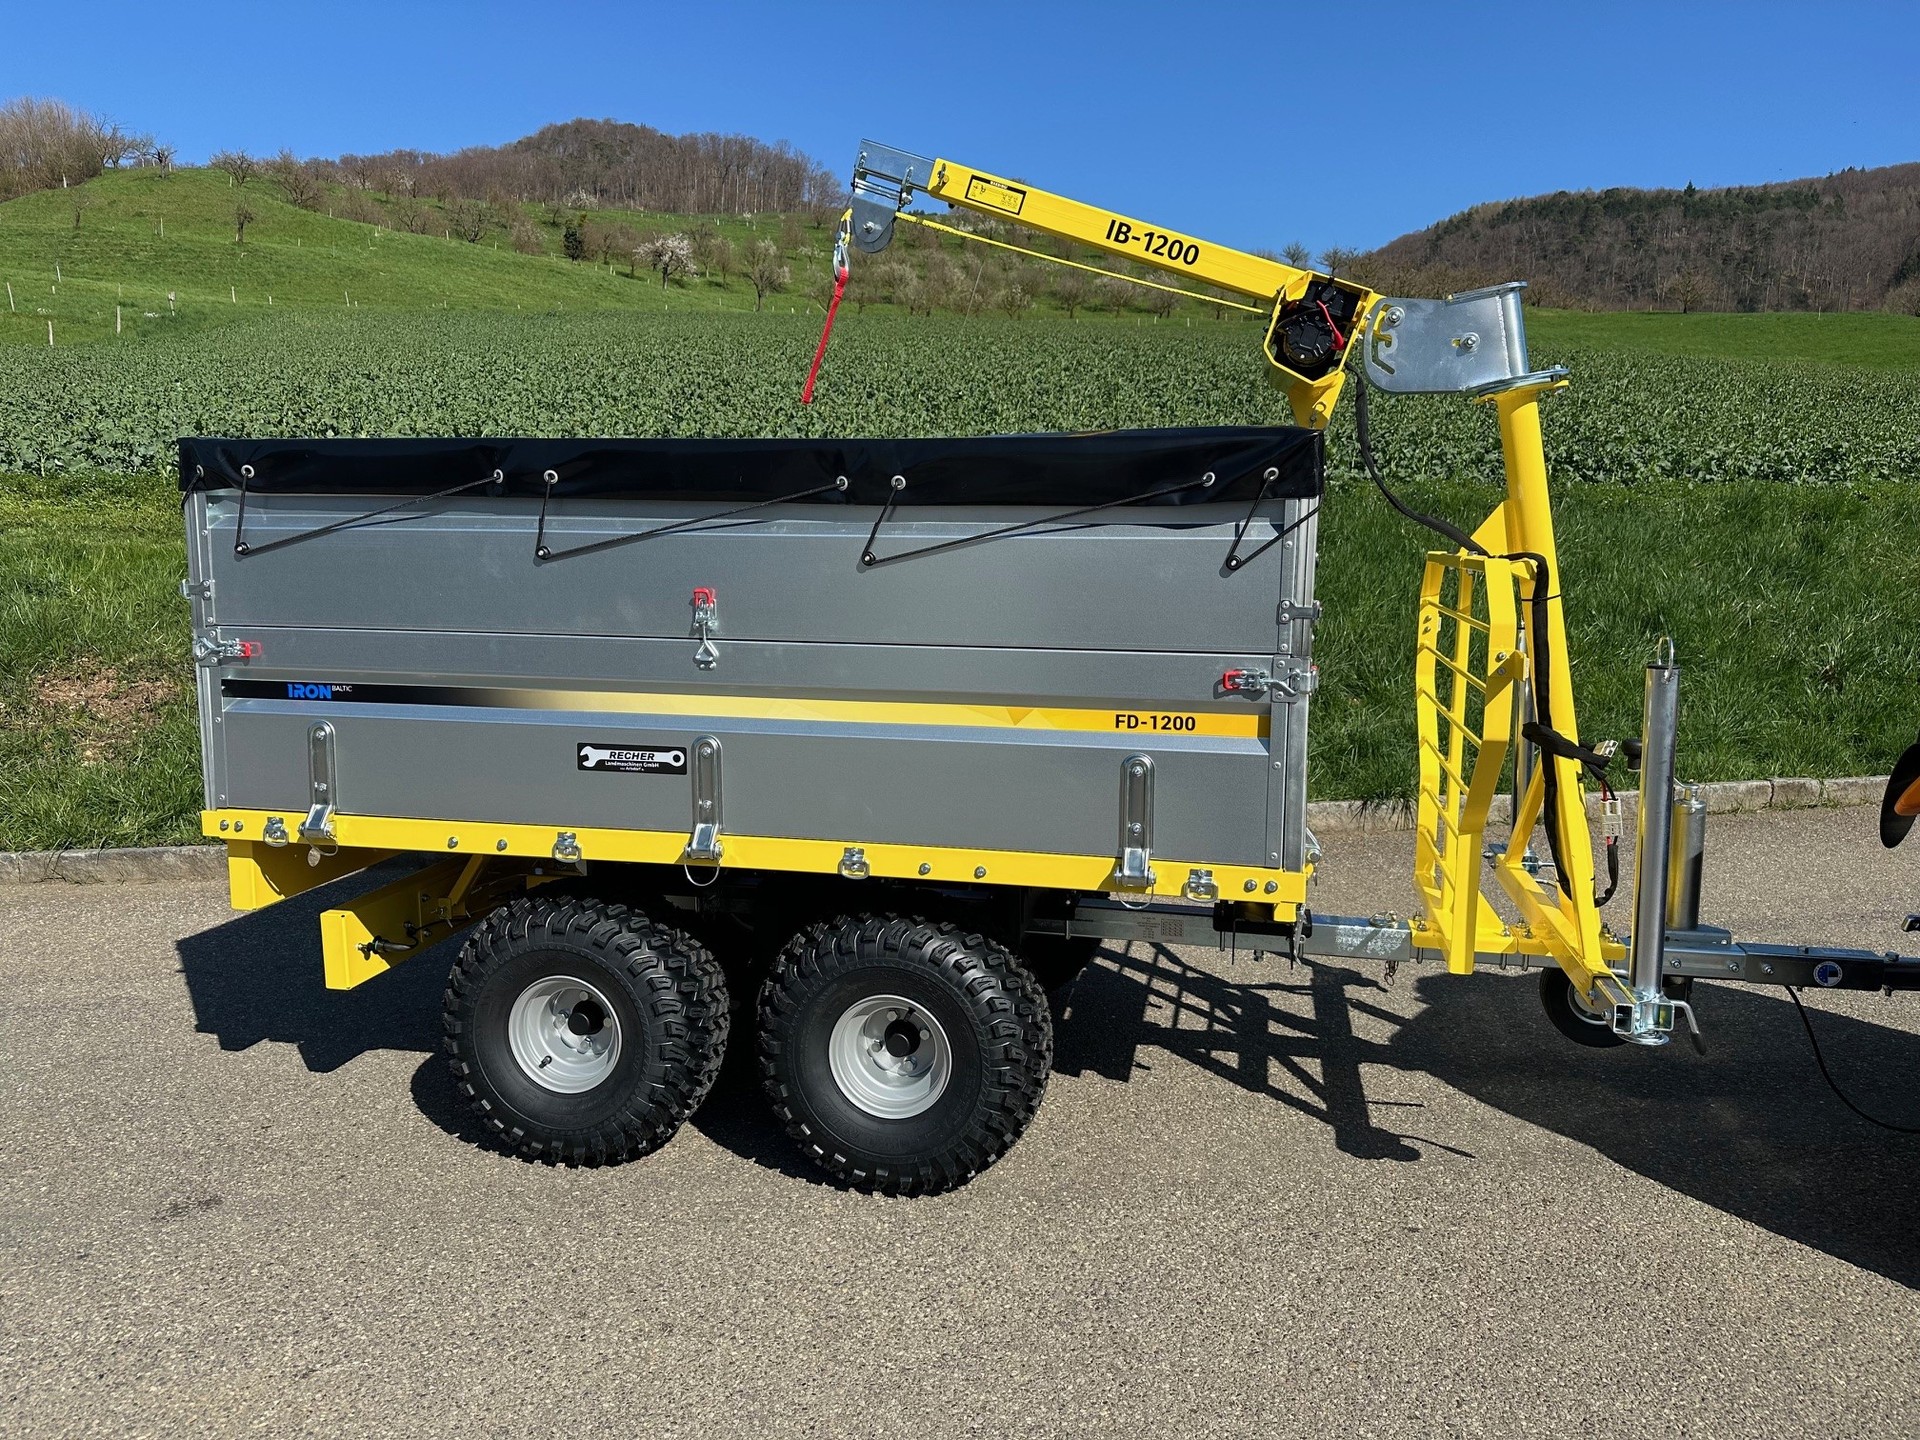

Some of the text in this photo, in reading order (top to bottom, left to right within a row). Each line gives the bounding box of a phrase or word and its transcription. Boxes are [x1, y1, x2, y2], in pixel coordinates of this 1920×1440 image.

[1105, 219, 1200, 266] IB-1200
[287, 683, 332, 699] IRON
[1115, 714, 1196, 731] FD-1200
[609, 751, 655, 761] RECHER
